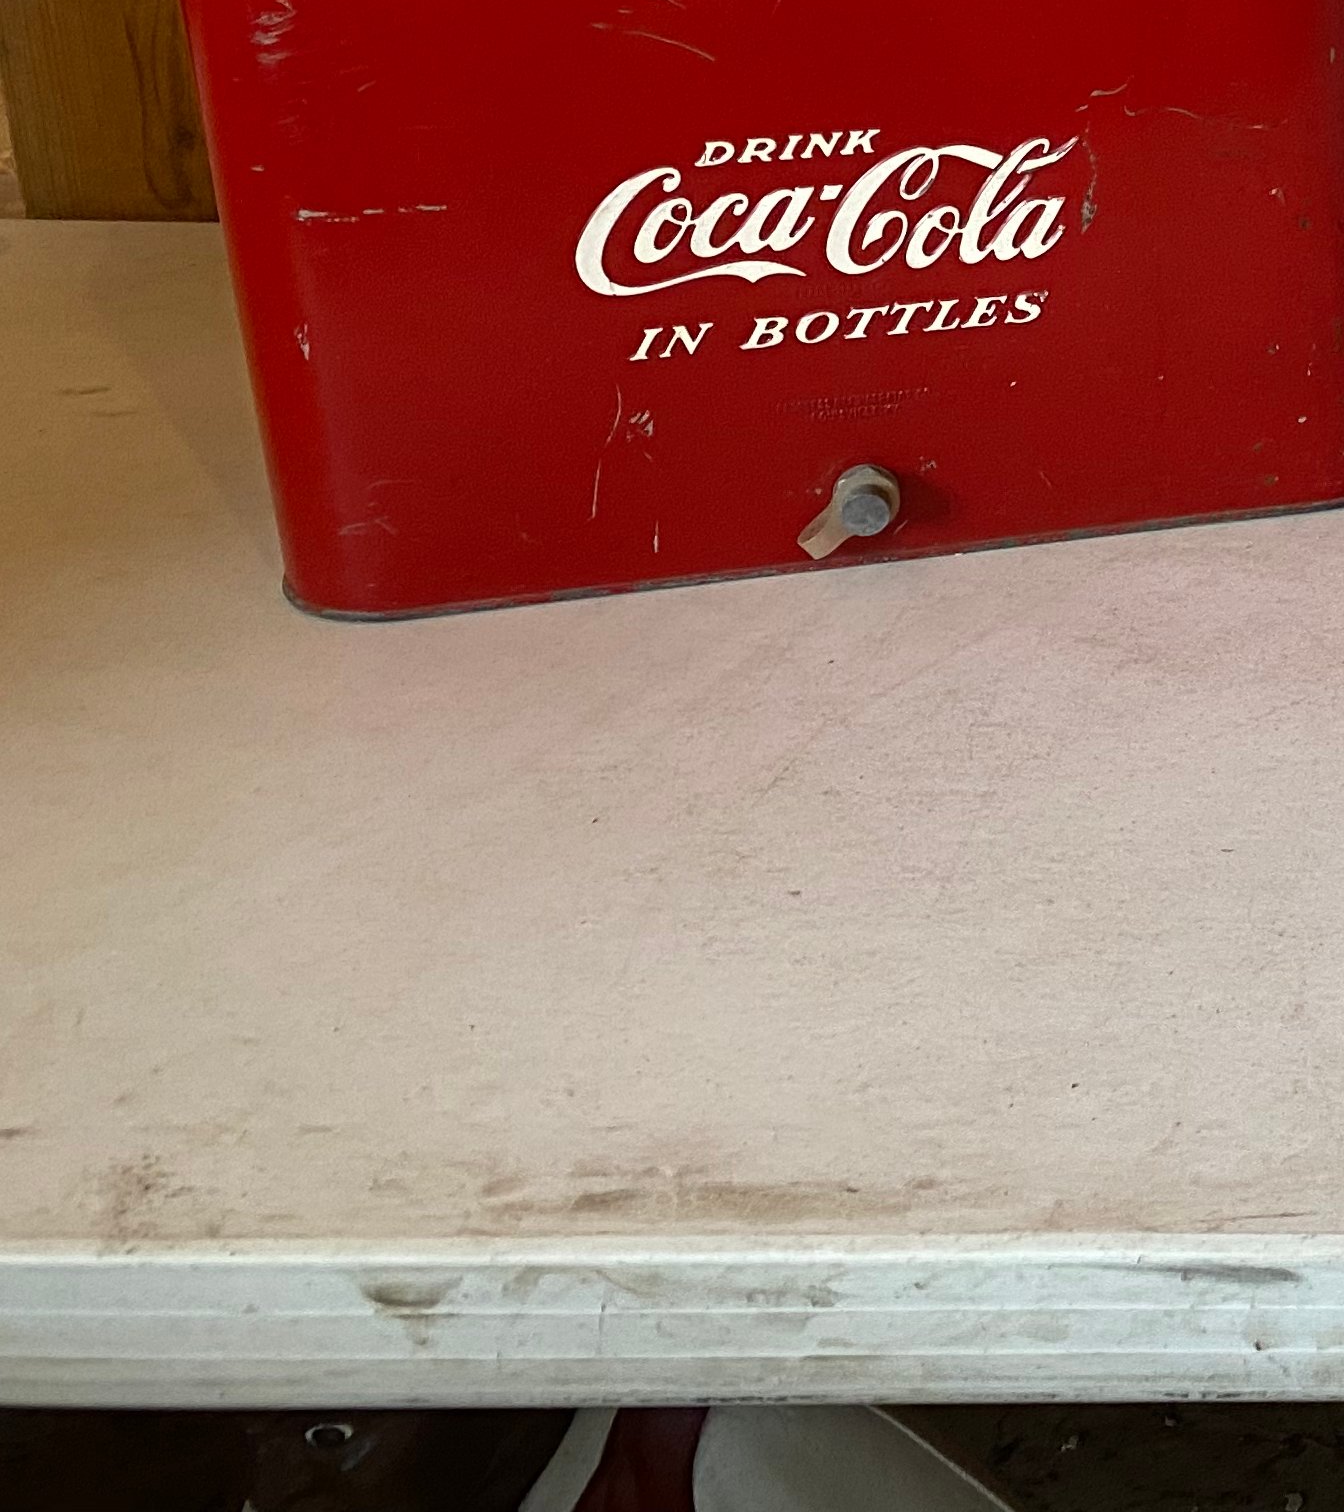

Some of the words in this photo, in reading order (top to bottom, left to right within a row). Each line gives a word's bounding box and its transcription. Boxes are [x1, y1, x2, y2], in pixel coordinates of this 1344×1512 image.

[694, 128, 882, 168] DRINK
[574, 136, 1080, 297] Coca-Cola
[628, 322, 714, 362] IN
[739, 290, 1050, 351] BOTTLES
